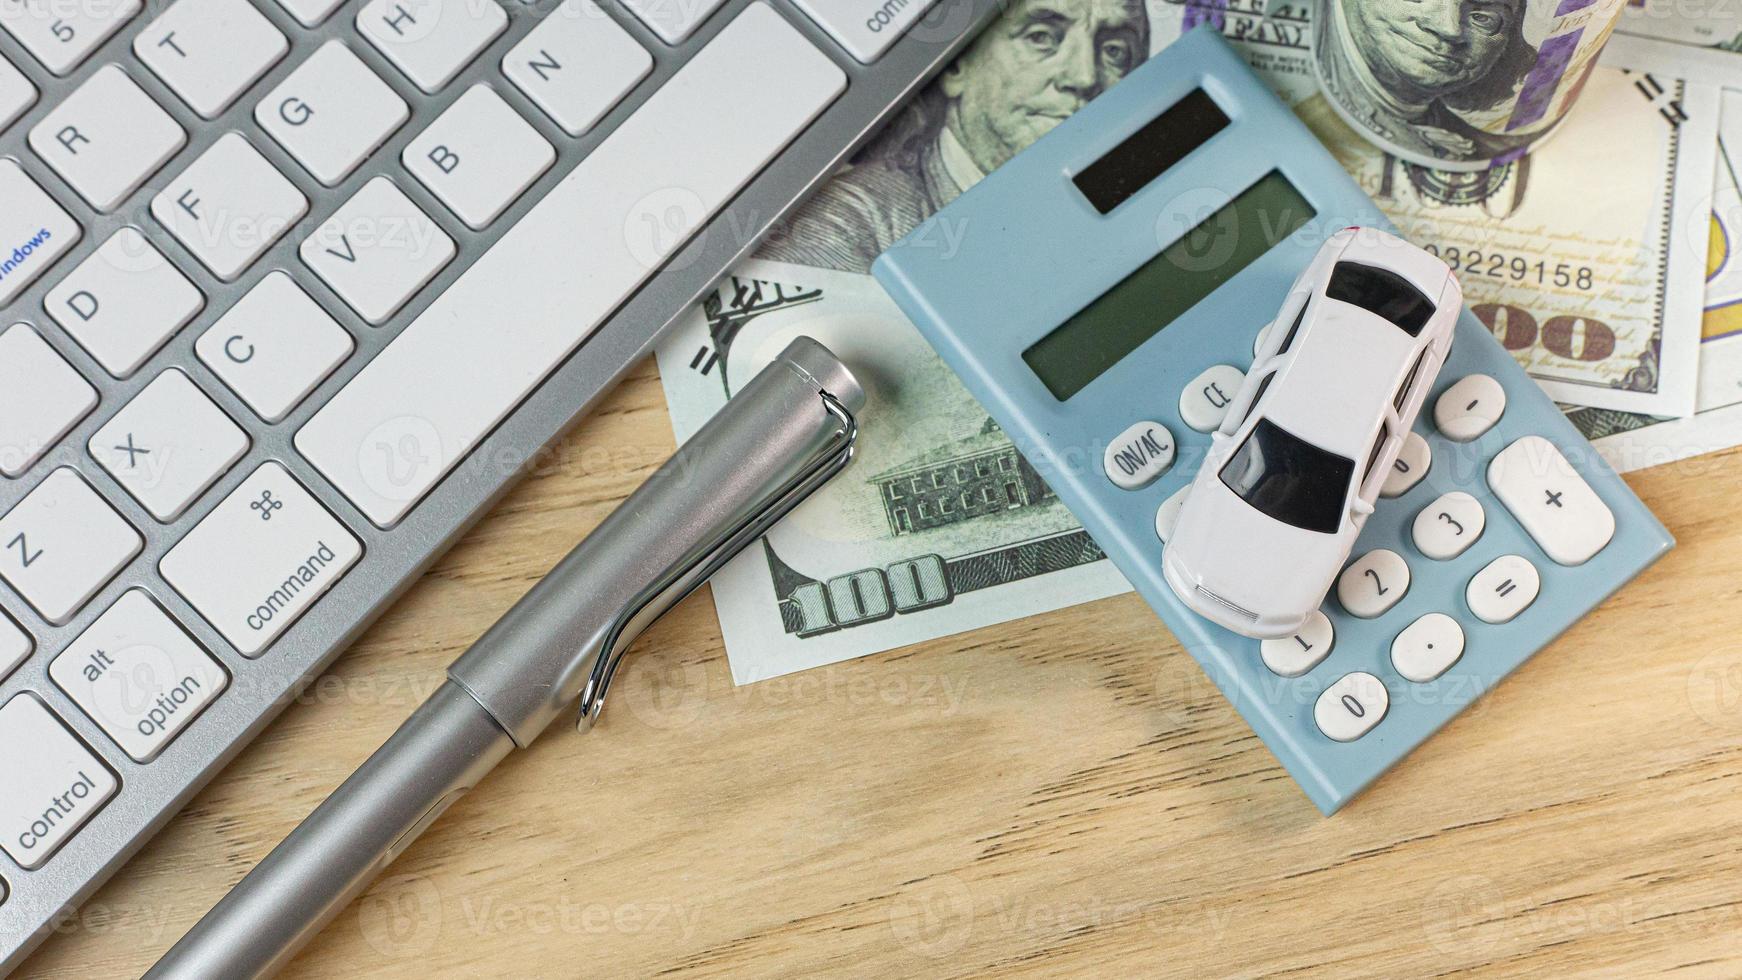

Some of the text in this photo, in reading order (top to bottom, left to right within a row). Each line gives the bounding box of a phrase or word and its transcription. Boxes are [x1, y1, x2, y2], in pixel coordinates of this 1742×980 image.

[51, 20, 74, 42] 5
[383, 5, 415, 35] H
[158, 32, 186, 57] T
[528, 50, 561, 80] N
[280, 98, 314, 126] G
[56, 126, 90, 154] R
[428, 146, 459, 174] B
[177, 189, 200, 220] F
[0, 228, 51, 280] indows
[326, 234, 356, 262] V
[67, 291, 98, 321] D
[225, 336, 254, 363] C
[115, 433, 150, 468] X
[1114, 429, 1168, 475] ON/AC
[1439, 513, 1463, 535] 3
[7, 533, 43, 567] Z
[247, 541, 336, 631] command
[786, 552, 955, 639] 100
[1365, 569, 1388, 595] 2
[1294, 635, 1312, 652] 1
[83, 650, 114, 681] alt
[138, 677, 201, 737] option
[1341, 695, 1365, 717] 0
[19, 771, 97, 850] control
